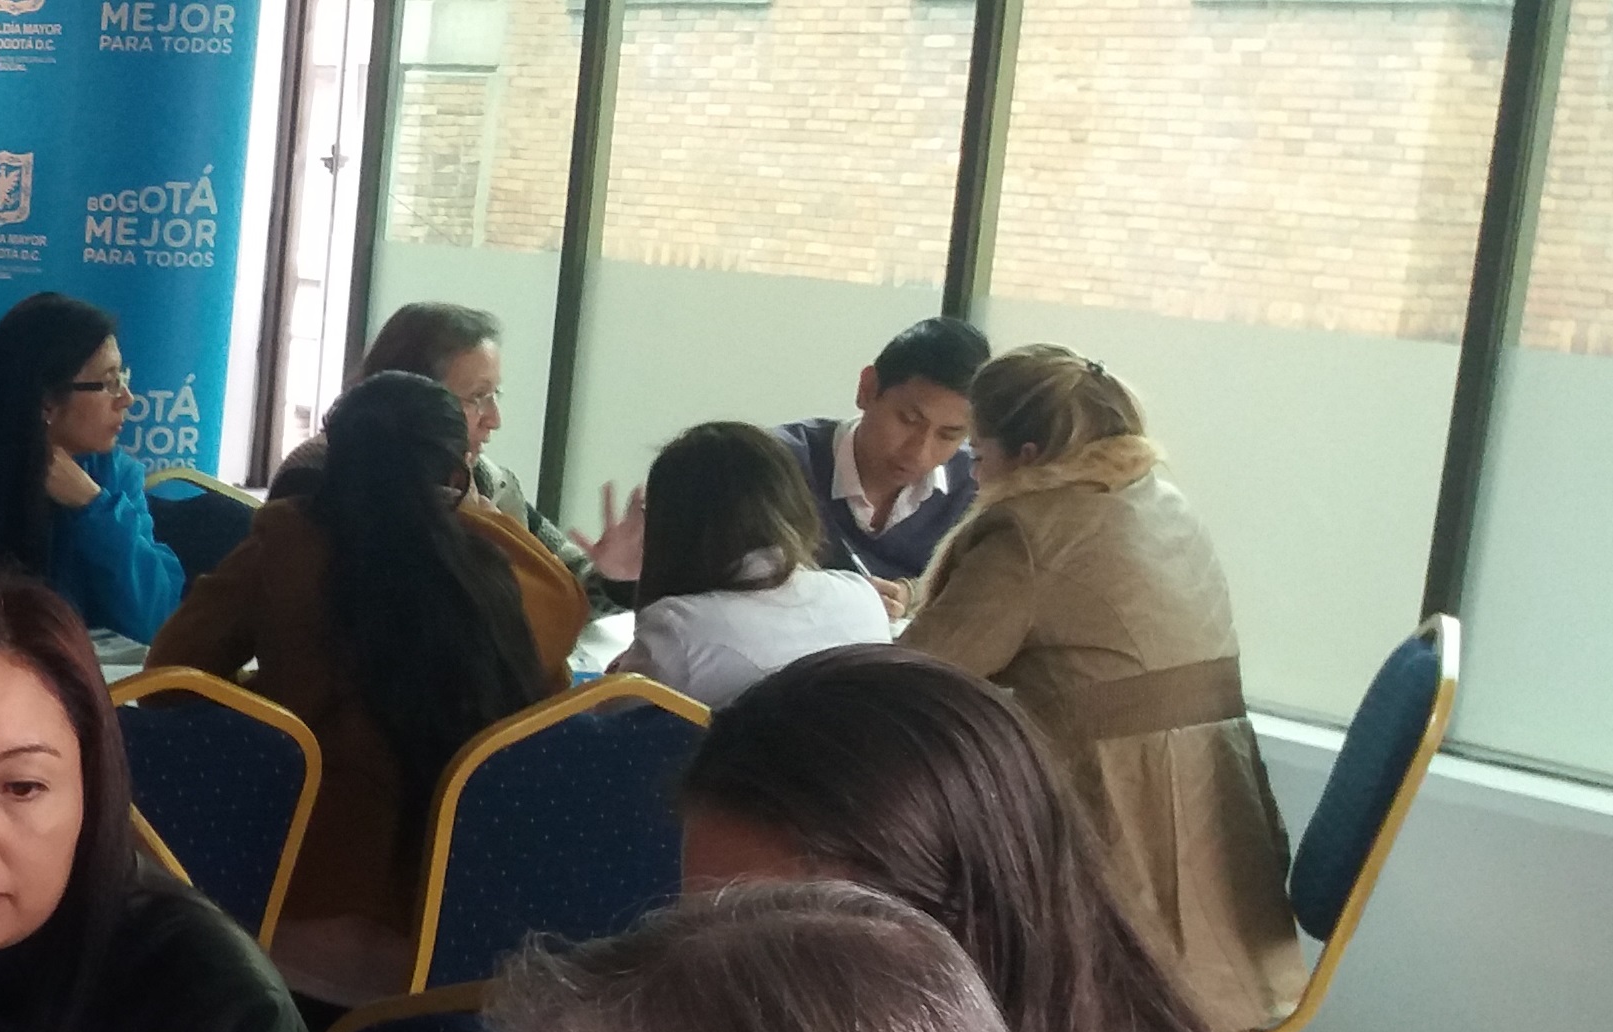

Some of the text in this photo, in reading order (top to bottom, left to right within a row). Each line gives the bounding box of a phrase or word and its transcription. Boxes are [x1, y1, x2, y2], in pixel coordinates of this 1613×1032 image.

[23, 23, 62, 35] MAYOR
[100, 2, 235, 34] MEJOR
[99, 34, 232, 54] PARA TODOS
[87, 164, 218, 215] BOGOTÁ
[85, 215, 218, 248] MEJOR
[83, 248, 214, 268] PARA TODOS
[124, 373, 200, 423] OTÁ
[124, 426, 199, 455] JOR
